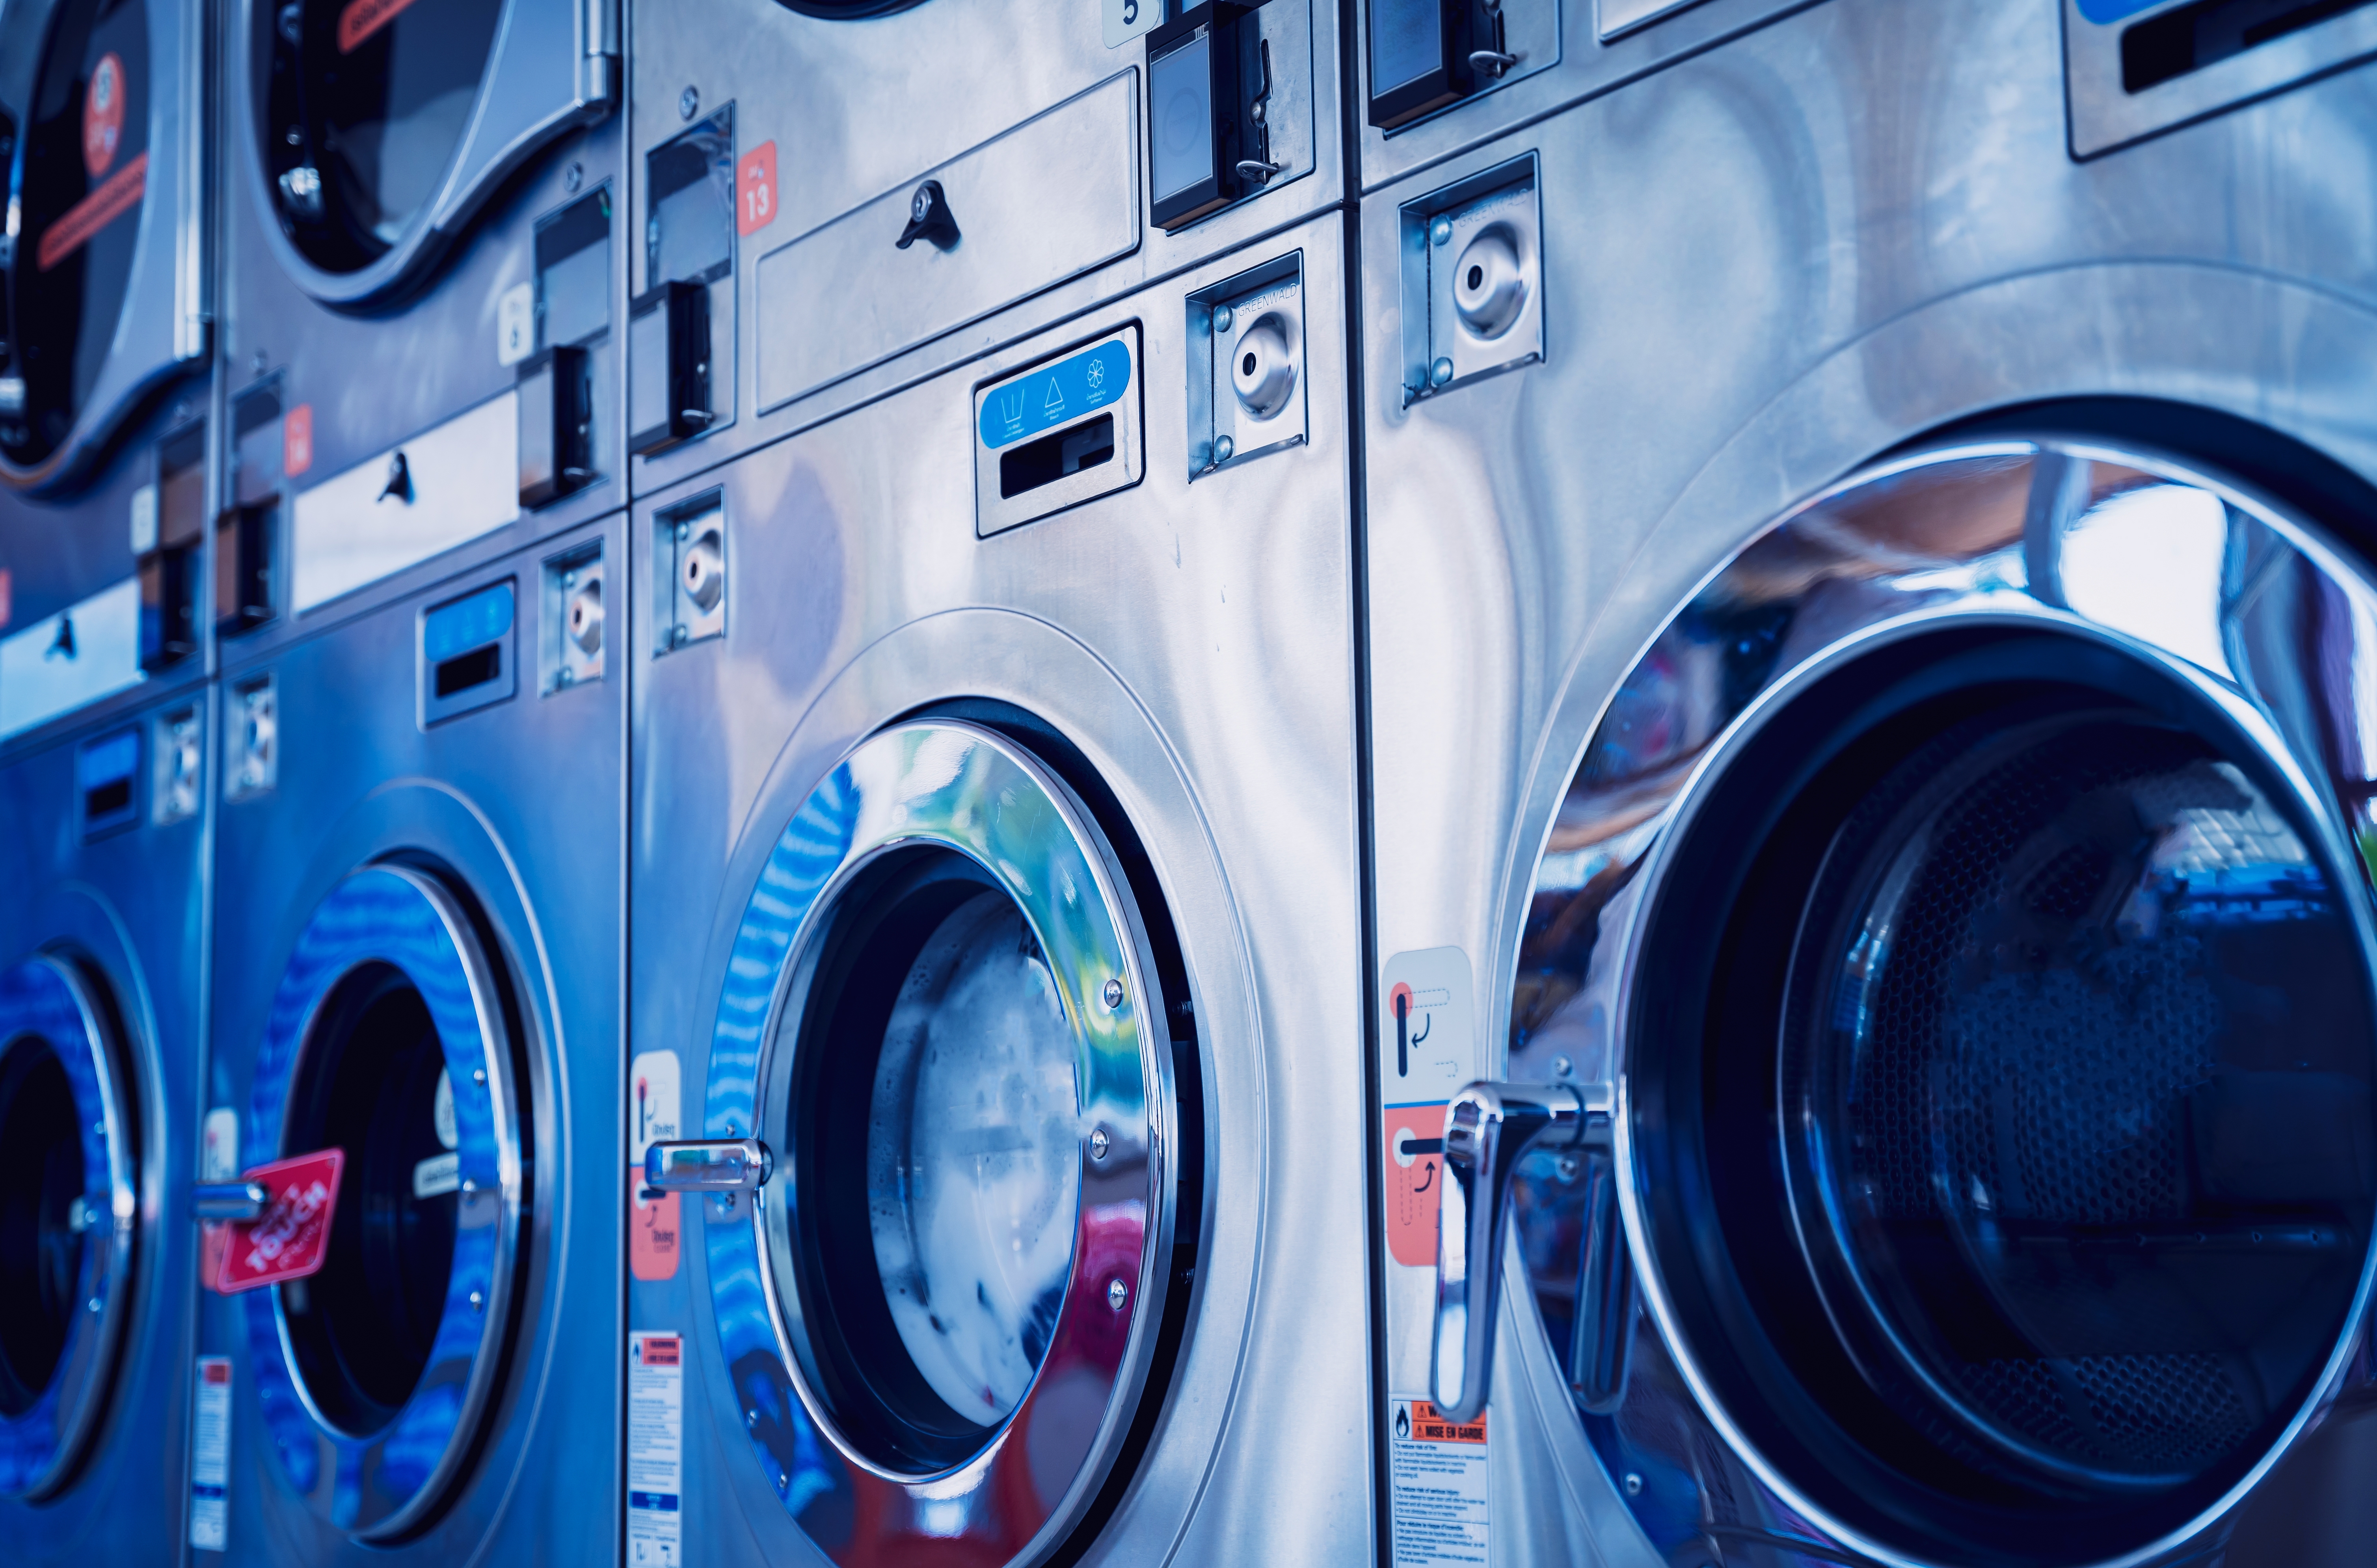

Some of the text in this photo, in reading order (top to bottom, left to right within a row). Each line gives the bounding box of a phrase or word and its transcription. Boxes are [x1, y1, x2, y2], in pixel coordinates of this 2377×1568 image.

[1123, 0, 1138, 25] 5
[746, 183, 770, 222] 13
[1238, 283, 1297, 316] GREENWALD
[1446, 1427, 1456, 1439] EN
